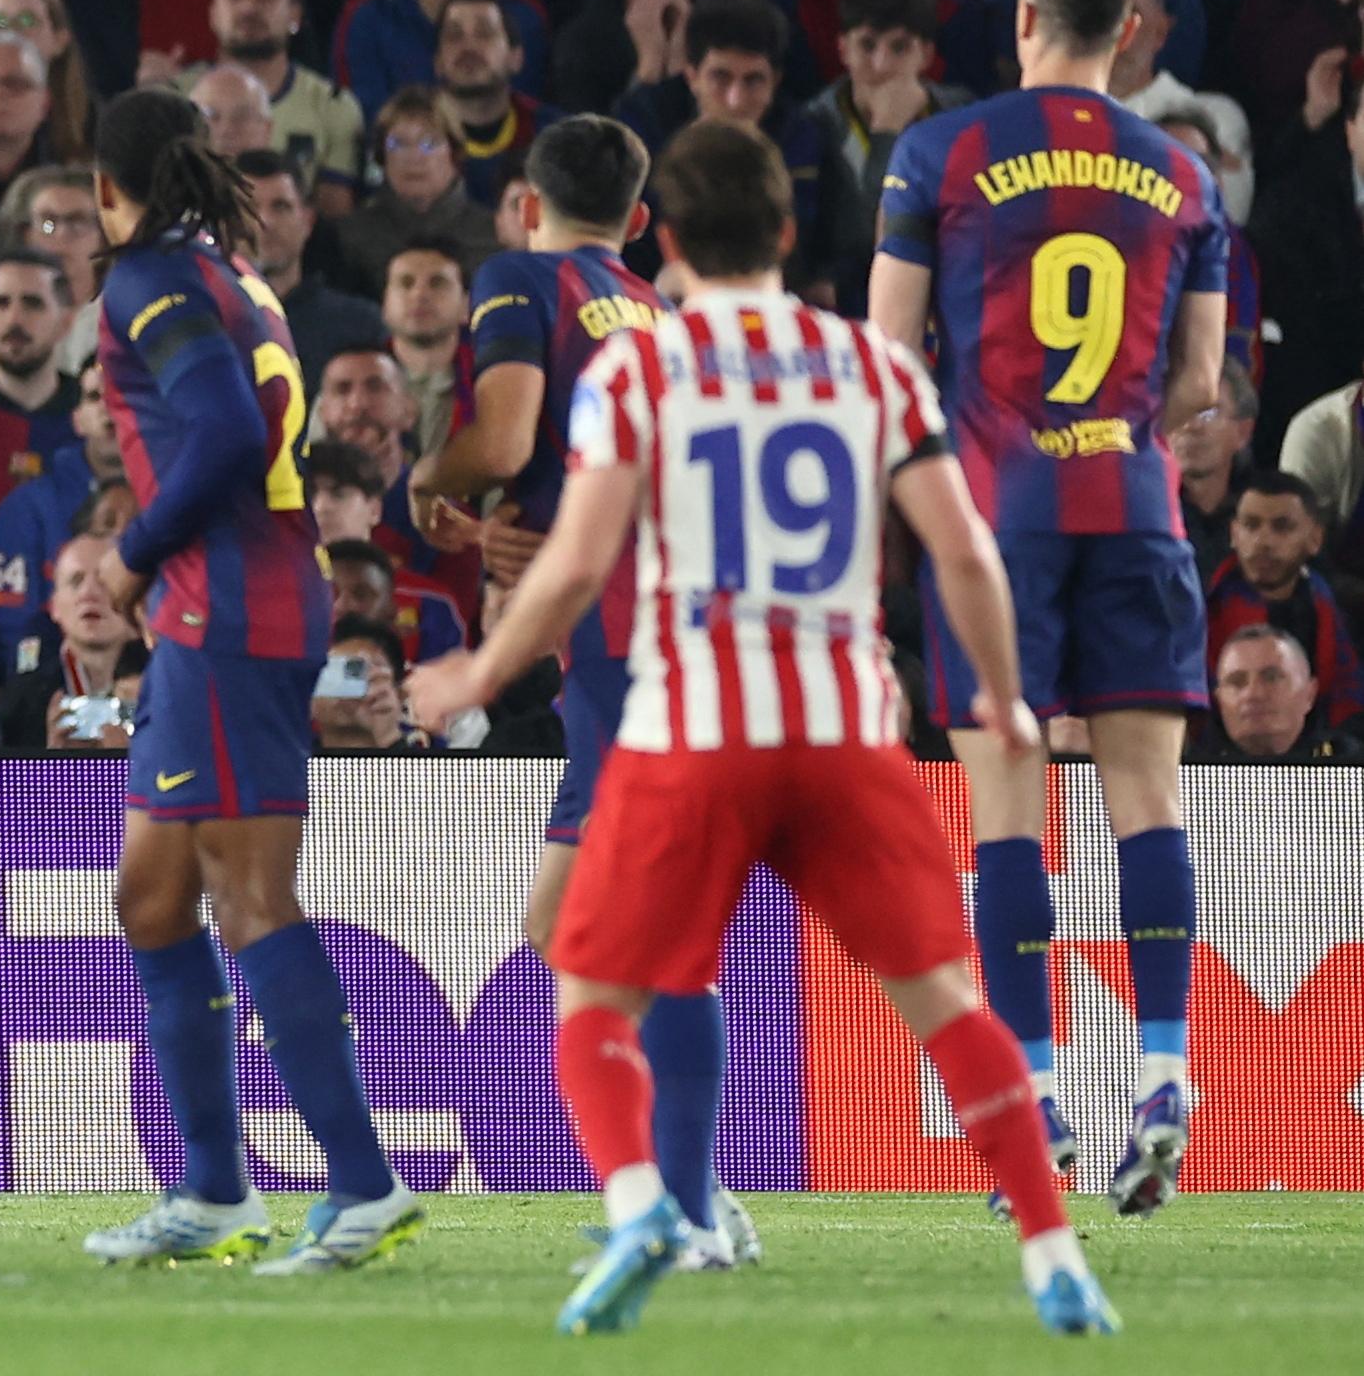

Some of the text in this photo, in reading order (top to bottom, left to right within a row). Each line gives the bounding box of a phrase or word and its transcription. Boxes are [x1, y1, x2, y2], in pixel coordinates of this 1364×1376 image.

[974, 149, 1184, 219] LEWANDOWSKI
[1030, 232, 1127, 405] 9
[252, 341, 312, 511] 2
[688, 420, 858, 596] 19
